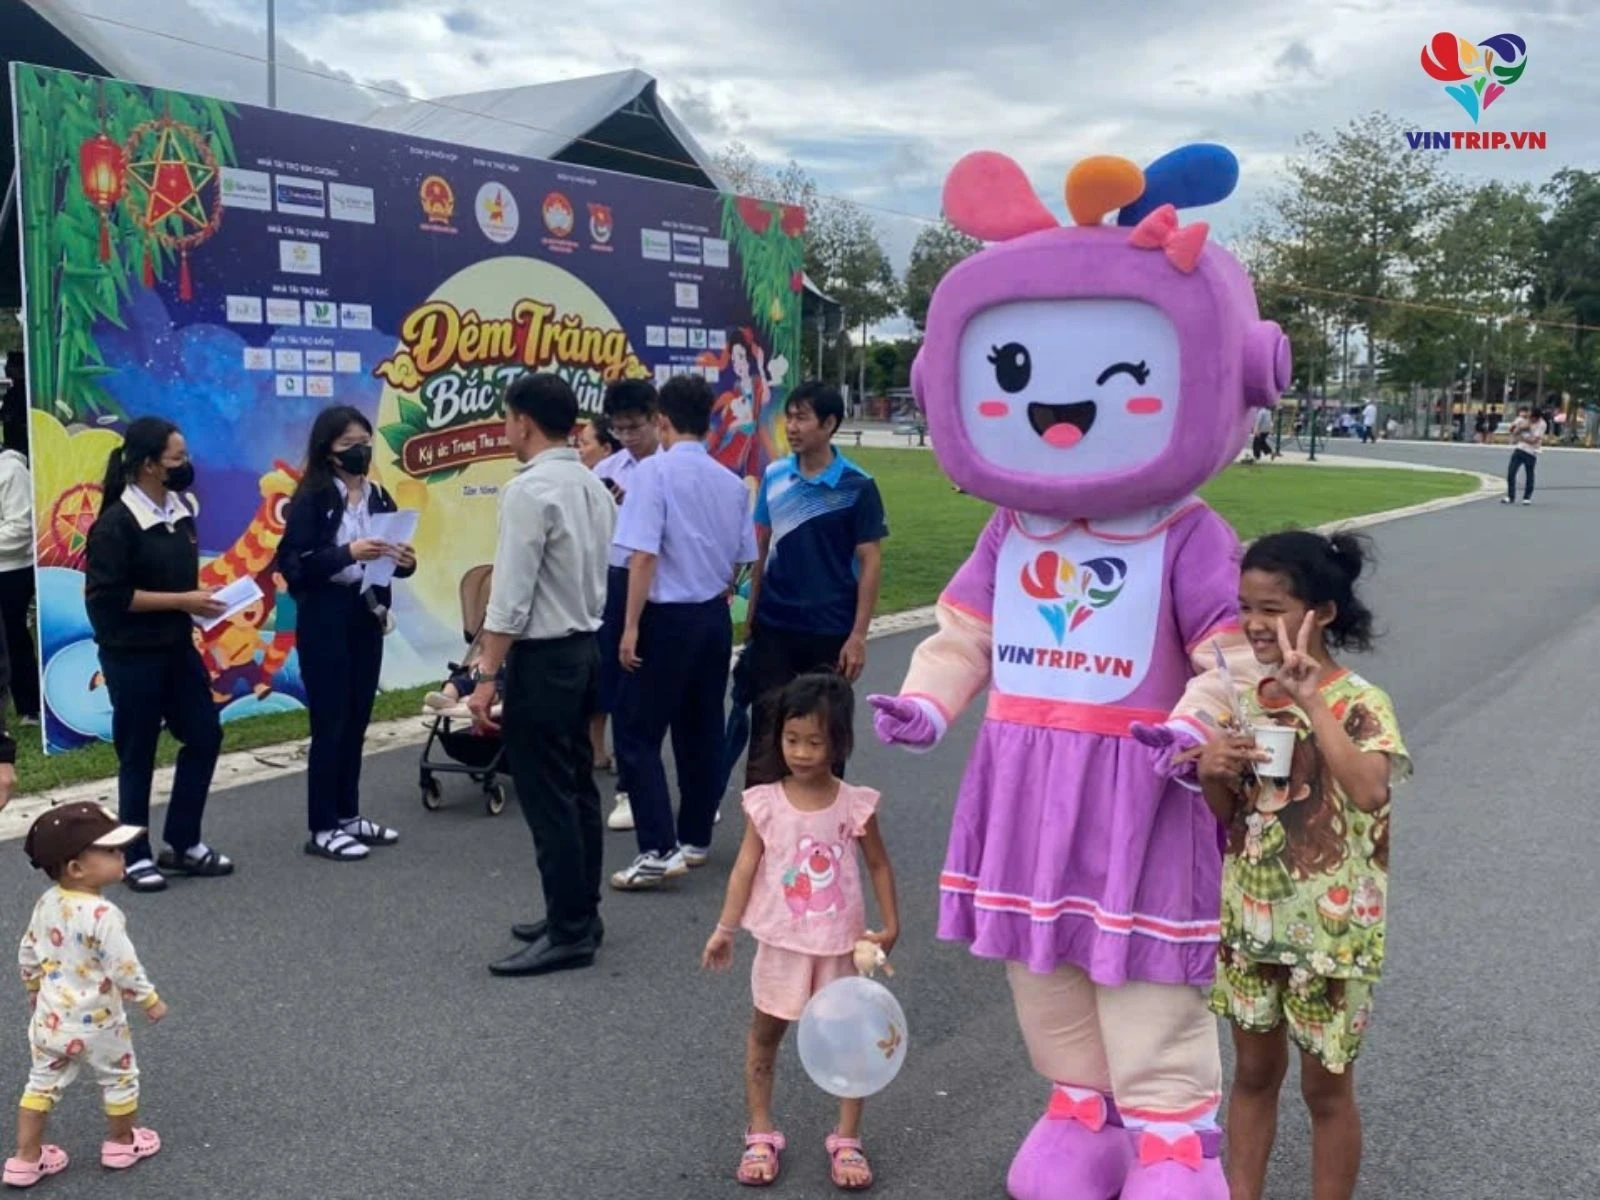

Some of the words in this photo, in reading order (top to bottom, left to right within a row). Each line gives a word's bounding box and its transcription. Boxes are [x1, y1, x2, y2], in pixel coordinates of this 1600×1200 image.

[402, 300, 516, 372] Đêm
[513, 298, 628, 380] Trăng
[427, 370, 494, 428] Bắc
[419, 445, 433, 466] Ký
[452, 439, 476, 456] Trung
[479, 433, 494, 449] Thu
[998, 644, 1134, 679] VINTRIP.VN
